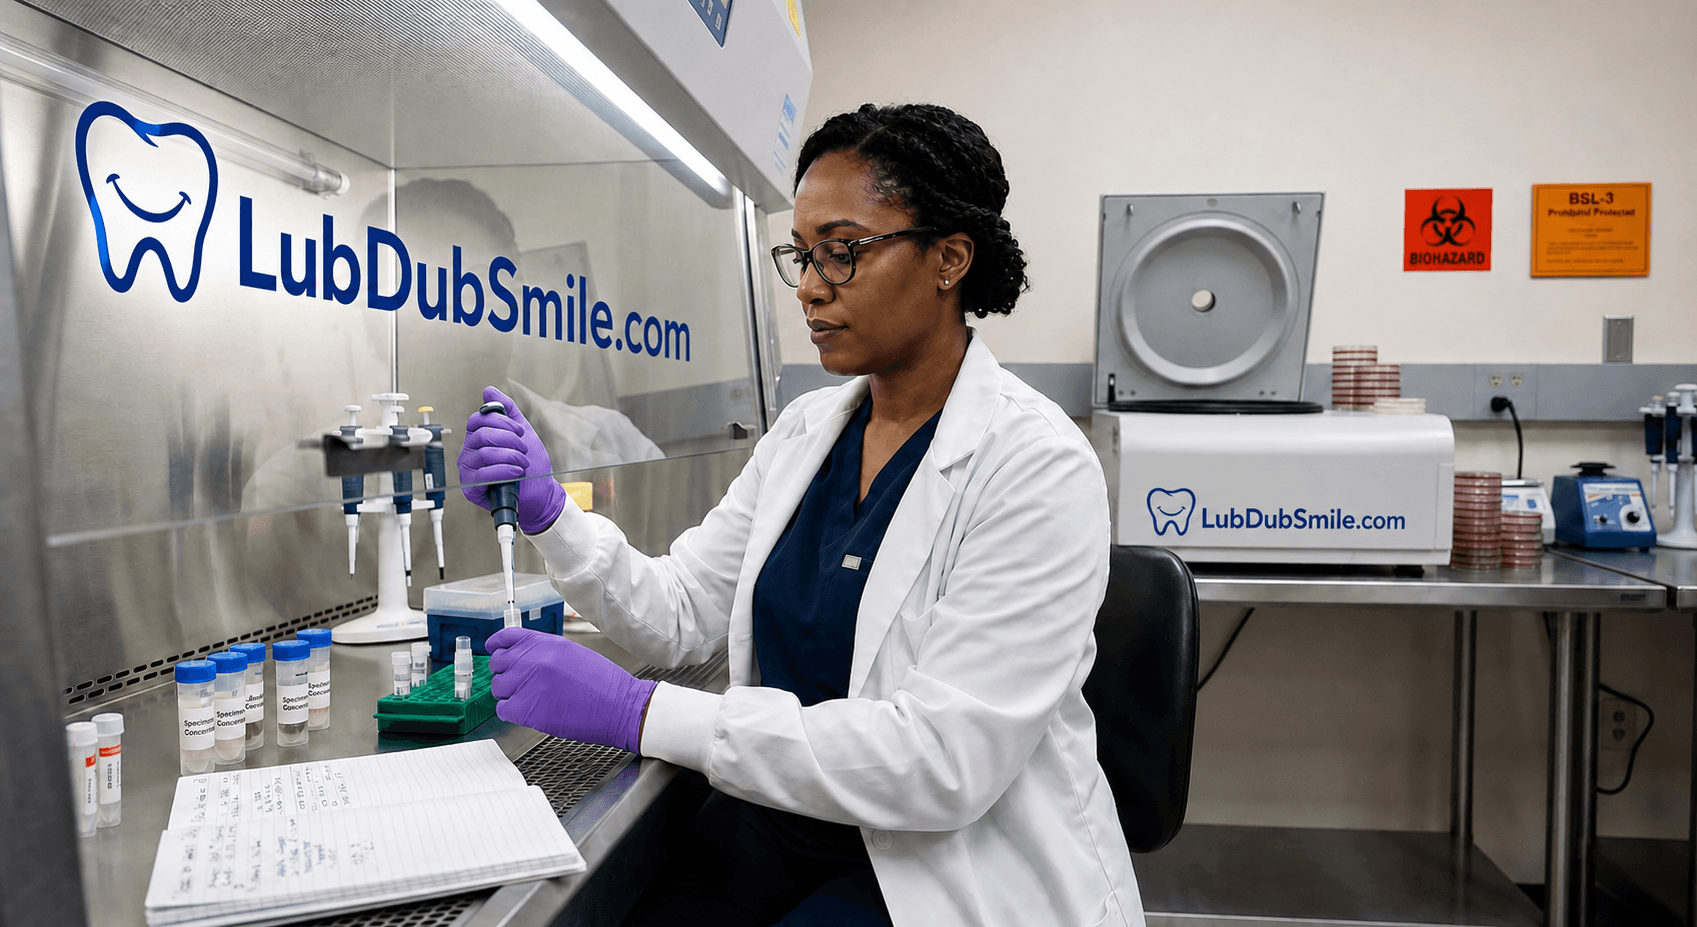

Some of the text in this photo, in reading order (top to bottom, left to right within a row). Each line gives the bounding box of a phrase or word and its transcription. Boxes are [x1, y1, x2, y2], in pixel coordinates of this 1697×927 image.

[1569, 192, 1614, 205] BSL-3
[1409, 251, 1485, 265] BIOHAZARD
[239, 196, 691, 362] LubDubSmile.com
[1202, 507, 1405, 530] LubDubSmile.com
